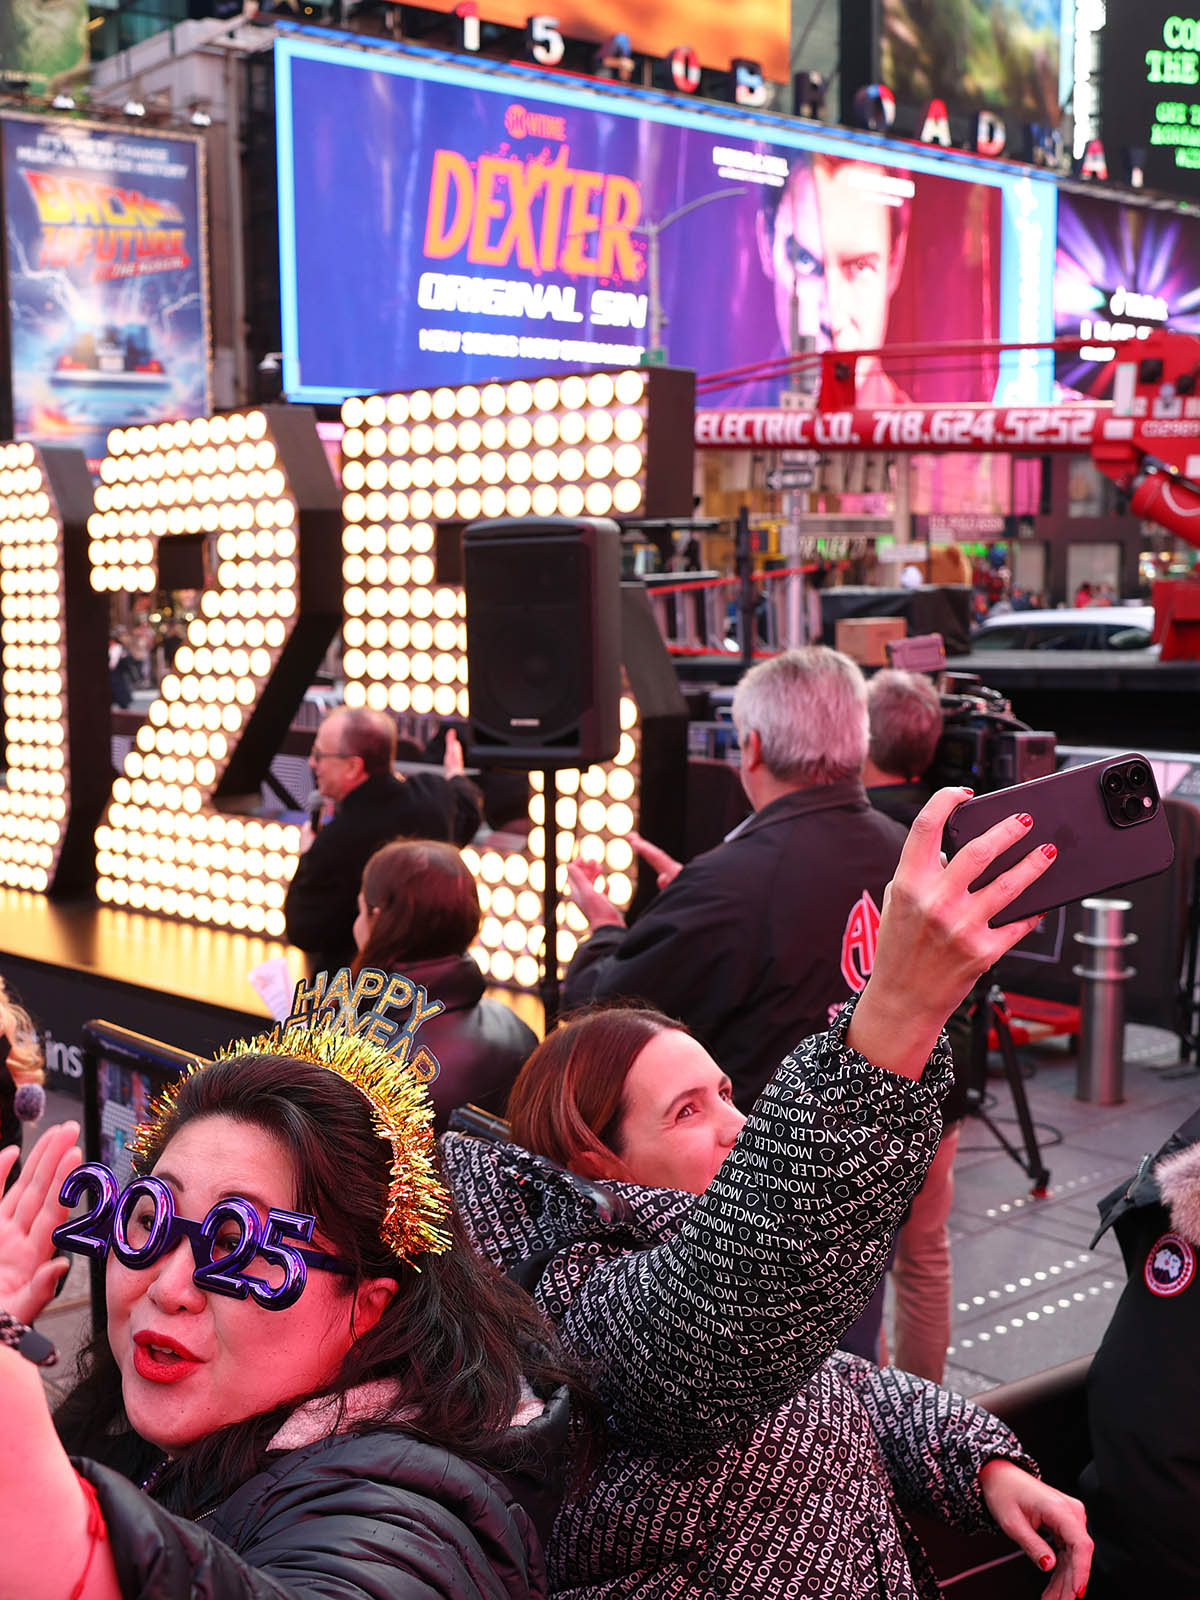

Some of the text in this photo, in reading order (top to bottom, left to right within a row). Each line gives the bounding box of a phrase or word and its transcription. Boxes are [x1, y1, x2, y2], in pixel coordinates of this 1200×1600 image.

[1145, 50, 1200, 84] THE
[22, 168, 184, 228] BACK
[423, 143, 646, 283] DEXTER
[417, 272, 648, 329] ORIGINAL SIN
[694, 408, 1097, 445] ELECTRIC CO. 718.624.5252
[287, 967, 447, 1034] HAPPY
[762, 1100, 816, 1124] MONCLER
[754, 1135, 812, 1159] MONCLER
[753, 1171, 816, 1194] MONCLER
[52, 1161, 318, 1312] 2025
[720, 1201, 780, 1232] MONCLER
[715, 1235, 780, 1263] MONCLER
[668, 1273, 717, 1316] MONCLER
[616, 1307, 654, 1361] MONCLER
[654, 1333, 714, 1370] MONCLER
[659, 1305, 713, 1345] MONCLER
[767, 1426, 801, 1493] MONCLER
[793, 1442, 825, 1507] MONCLER
[649, 1479, 681, 1543] MONCLER
[734, 1462, 771, 1526] MONCLER
[758, 1476, 799, 1541] MONCLER
[819, 1461, 842, 1523] MONCLER
[722, 1511, 765, 1574] MONCLER
[786, 1491, 821, 1557] MONCLER
[815, 1508, 843, 1574] MONCLER
[751, 1525, 792, 1593] MONCLER
[783, 1541, 820, 1600] MONCLER
